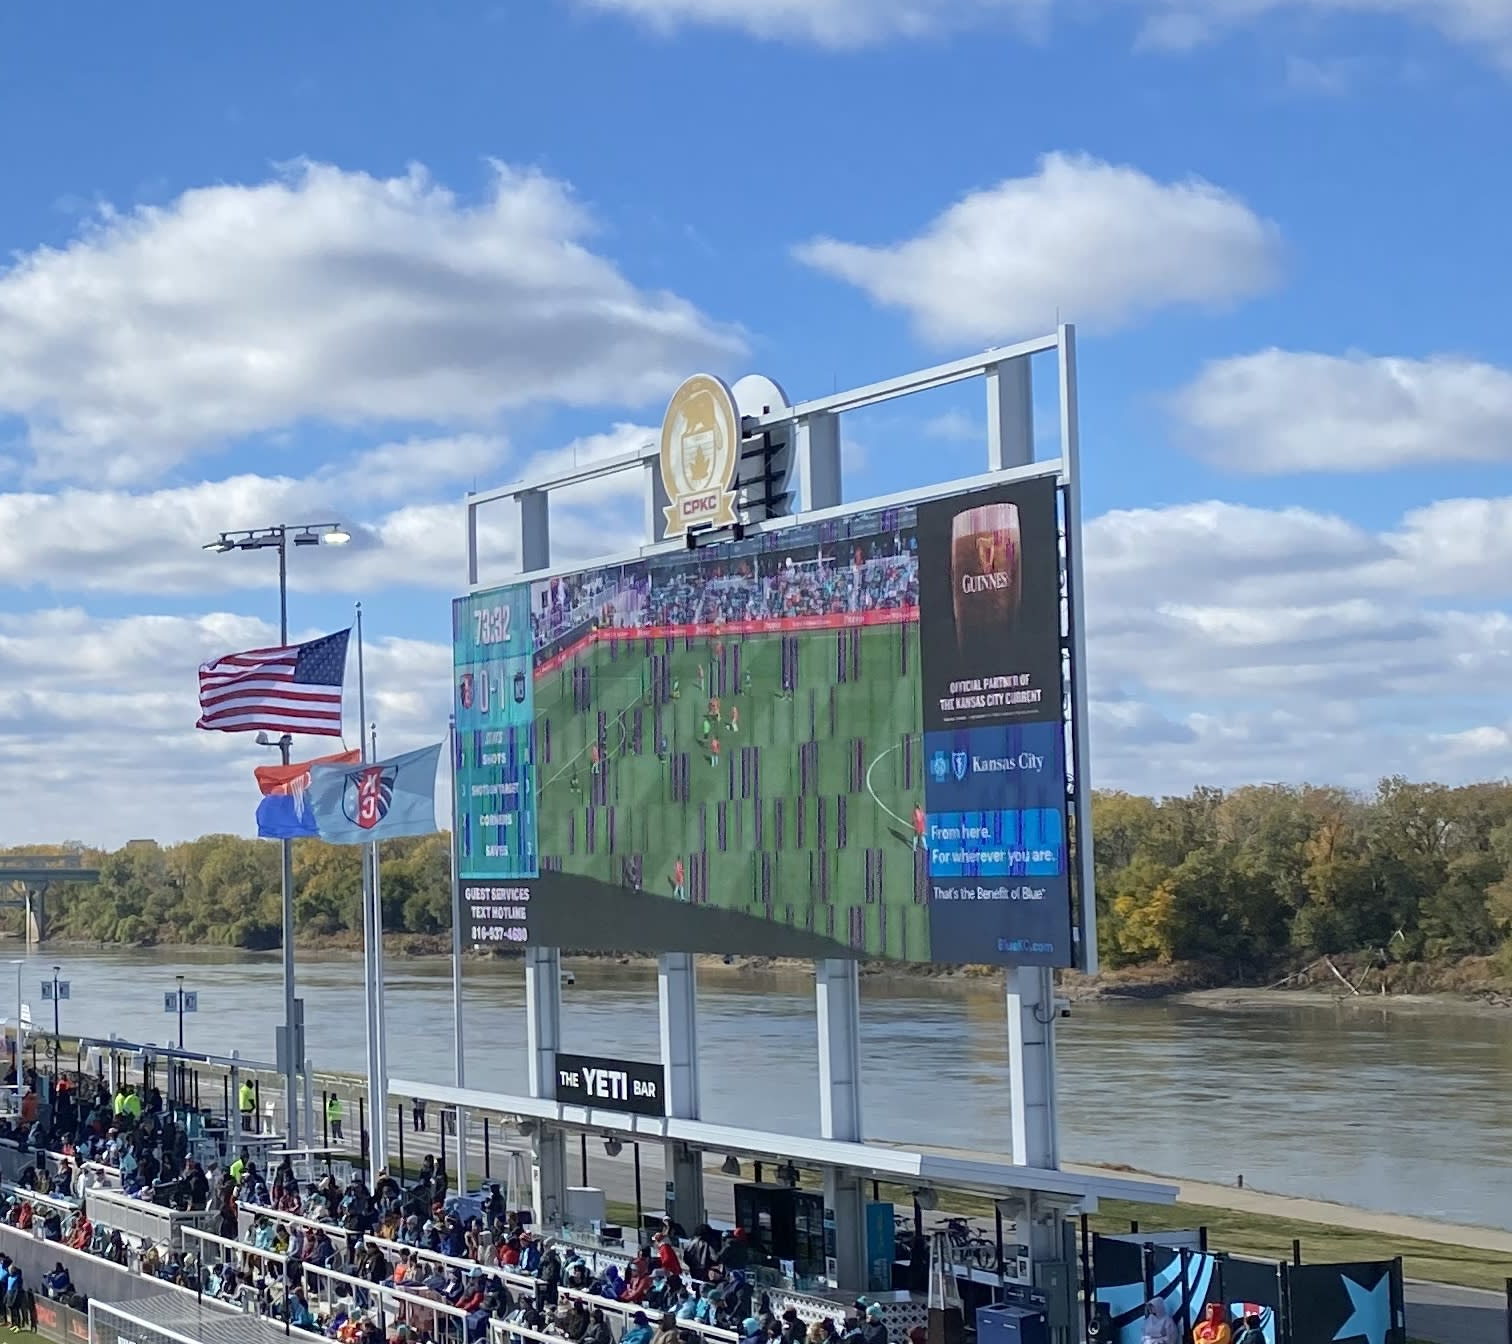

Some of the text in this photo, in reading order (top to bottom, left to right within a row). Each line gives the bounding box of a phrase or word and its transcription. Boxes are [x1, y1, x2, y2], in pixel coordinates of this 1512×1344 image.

[683, 496, 717, 515] CPKC
[474, 605, 511, 646] 73:32
[1019, 674, 1031, 687] OF
[940, 689, 1042, 711] THE KANSAS CITY CURRENT
[973, 752, 1044, 773] Kansas City
[931, 824, 991, 840] From here.
[932, 848, 1057, 867] For wherever you are.
[465, 887, 530, 901] GUEST SERVICES
[933, 887, 959, 900] That's
[960, 887, 975, 900] the
[977, 887, 1009, 900] Benefit
[1011, 886, 1020, 900] of
[471, 906, 526, 919] TEXT HOTLINE
[560, 1067, 656, 1101] THE YETI BAR
